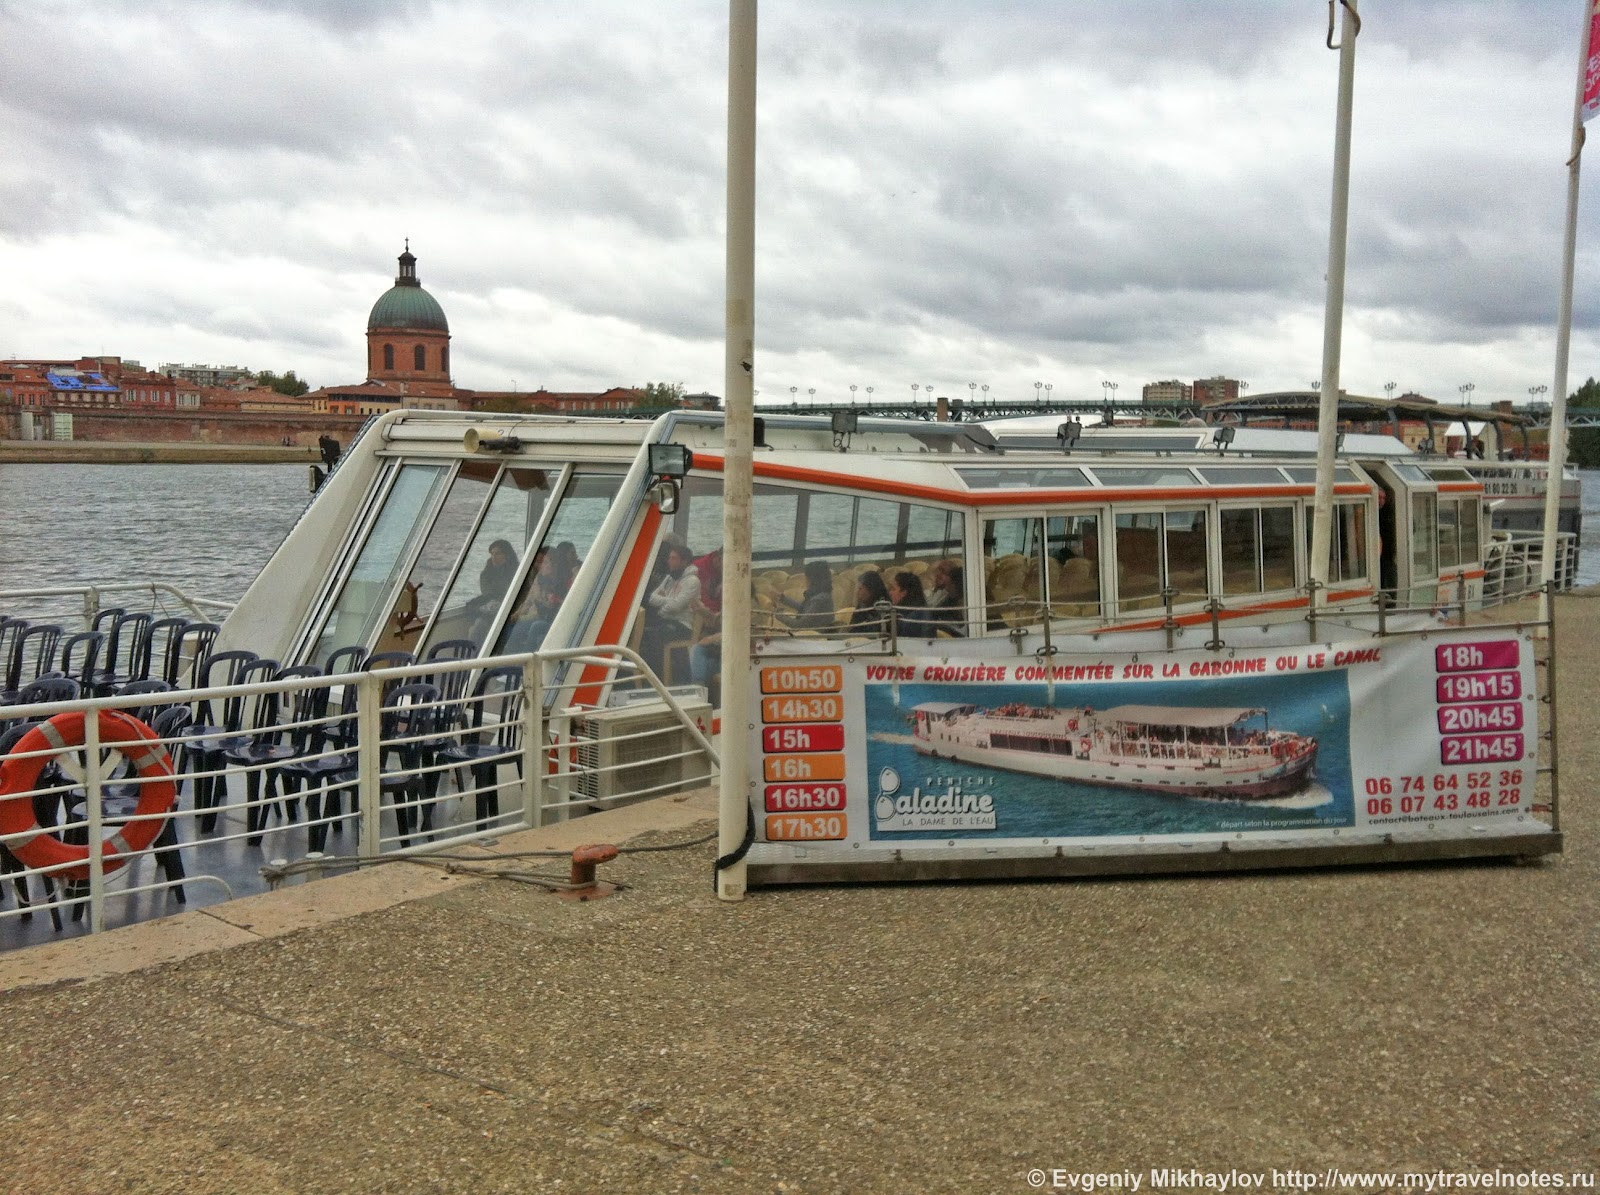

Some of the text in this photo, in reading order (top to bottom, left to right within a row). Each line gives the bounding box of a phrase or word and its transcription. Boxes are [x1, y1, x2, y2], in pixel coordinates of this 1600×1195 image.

[866, 648, 1382, 682] VOTRE CROISIÈRE COMMENTÉE SUR LA GARONNE OU LE CANAL
[1443, 646, 1483, 668] 18h
[768, 669, 836, 690] 10h50
[1443, 675, 1514, 699] 19h15
[769, 700, 837, 720] 14h30
[1444, 706, 1517, 730] 20h45
[770, 729, 811, 749] 15h
[1447, 737, 1518, 761] 21h45
[771, 759, 812, 779] 16h
[1365, 768, 1523, 796] 06 74 64 52 36
[772, 788, 840, 809] 16h30
[1367, 788, 1521, 815] 06 07 43 48 28
[773, 817, 841, 838] 17h30
[920, 818, 946, 826] DAME
[952, 817, 964, 825] DE
[970, 816, 994, 825] L'EAU
